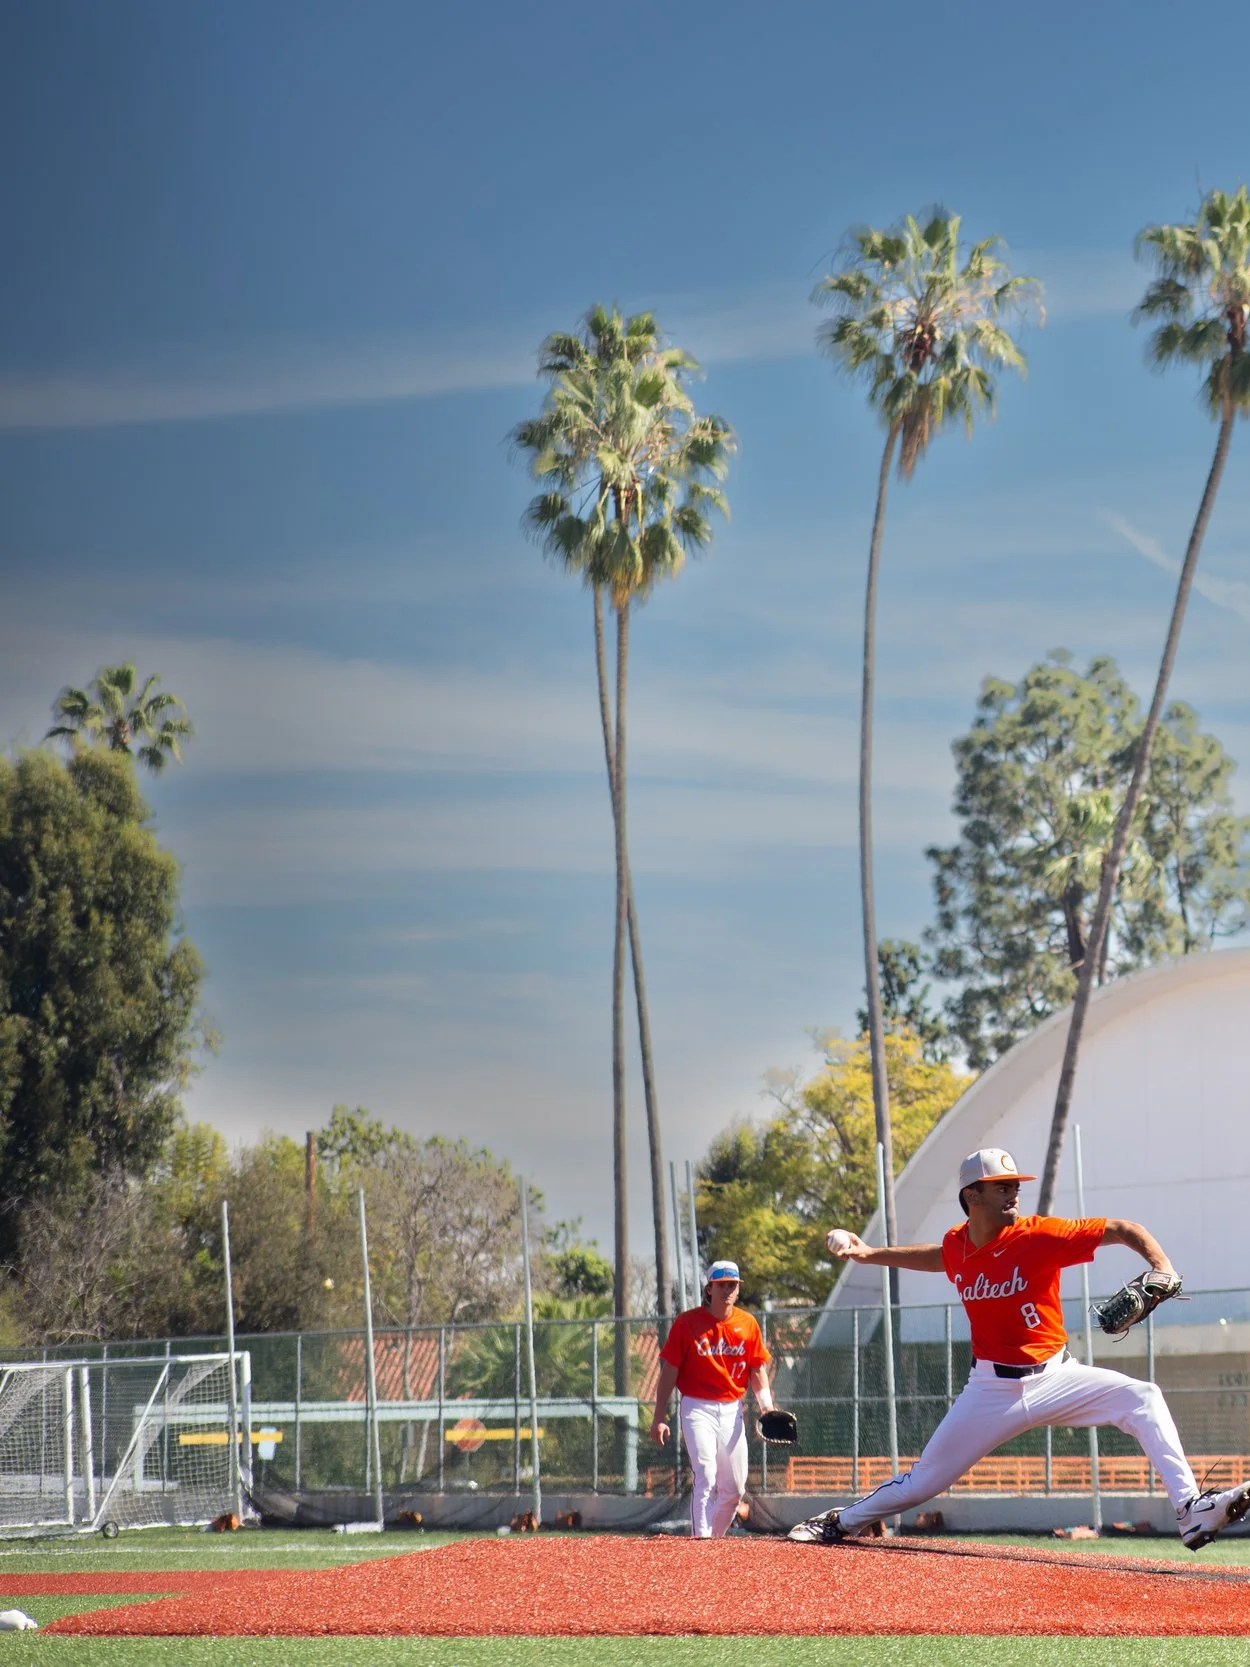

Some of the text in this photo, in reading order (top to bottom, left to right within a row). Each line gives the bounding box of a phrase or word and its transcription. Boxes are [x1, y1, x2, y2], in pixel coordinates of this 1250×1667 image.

[955, 1266, 1028, 1302] Caltech
[1020, 1302, 1041, 1329] 8
[697, 1337, 746, 1357] Caltech
[731, 1361, 747, 1379] 17
